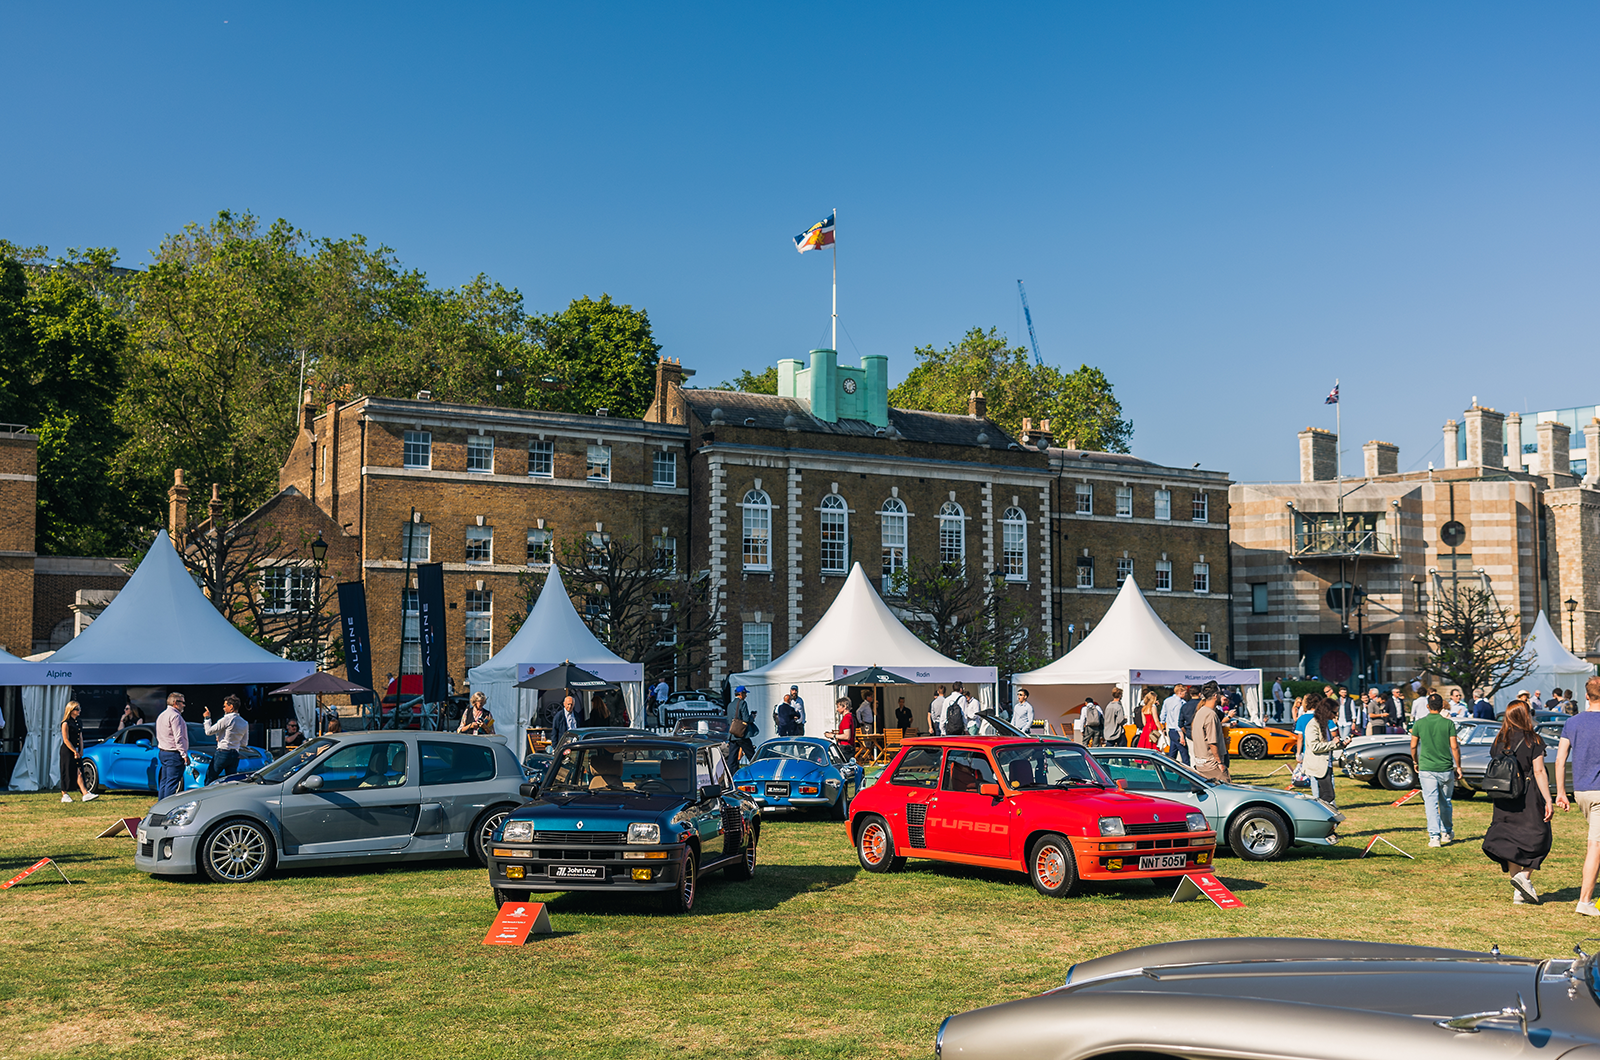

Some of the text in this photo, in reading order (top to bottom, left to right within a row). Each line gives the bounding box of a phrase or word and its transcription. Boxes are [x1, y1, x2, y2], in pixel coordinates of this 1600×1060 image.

[347, 616, 361, 673] ALPINE
[46, 669, 73, 679] Alpine
[926, 817, 1009, 835] TURBO
[1141, 855, 1186, 869] NNT 505W
[567, 866, 583, 874] John
